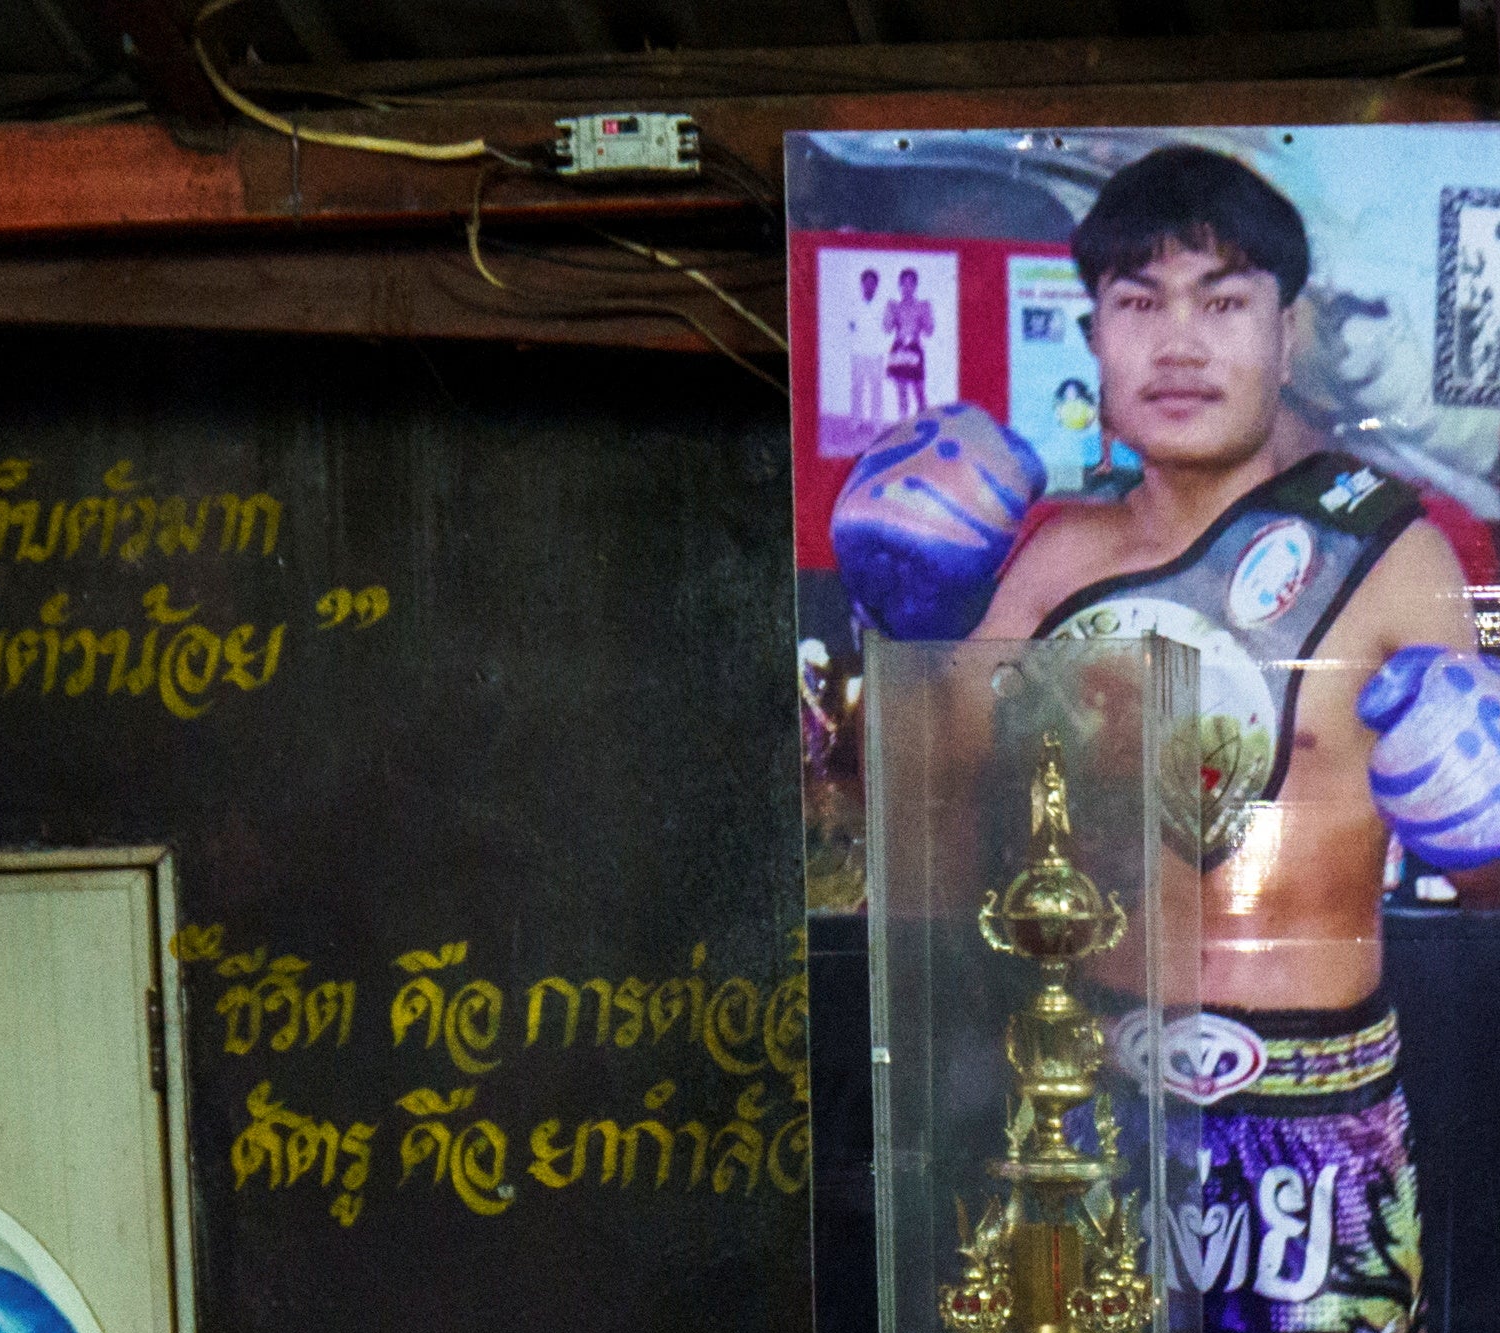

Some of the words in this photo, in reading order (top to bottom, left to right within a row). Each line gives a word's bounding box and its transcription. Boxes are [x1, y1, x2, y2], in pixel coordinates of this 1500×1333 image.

[390, 941, 503, 1075] คือ
[230, 1080, 378, 1228] ศัตรู
[397, 1087, 516, 1216] คือ
